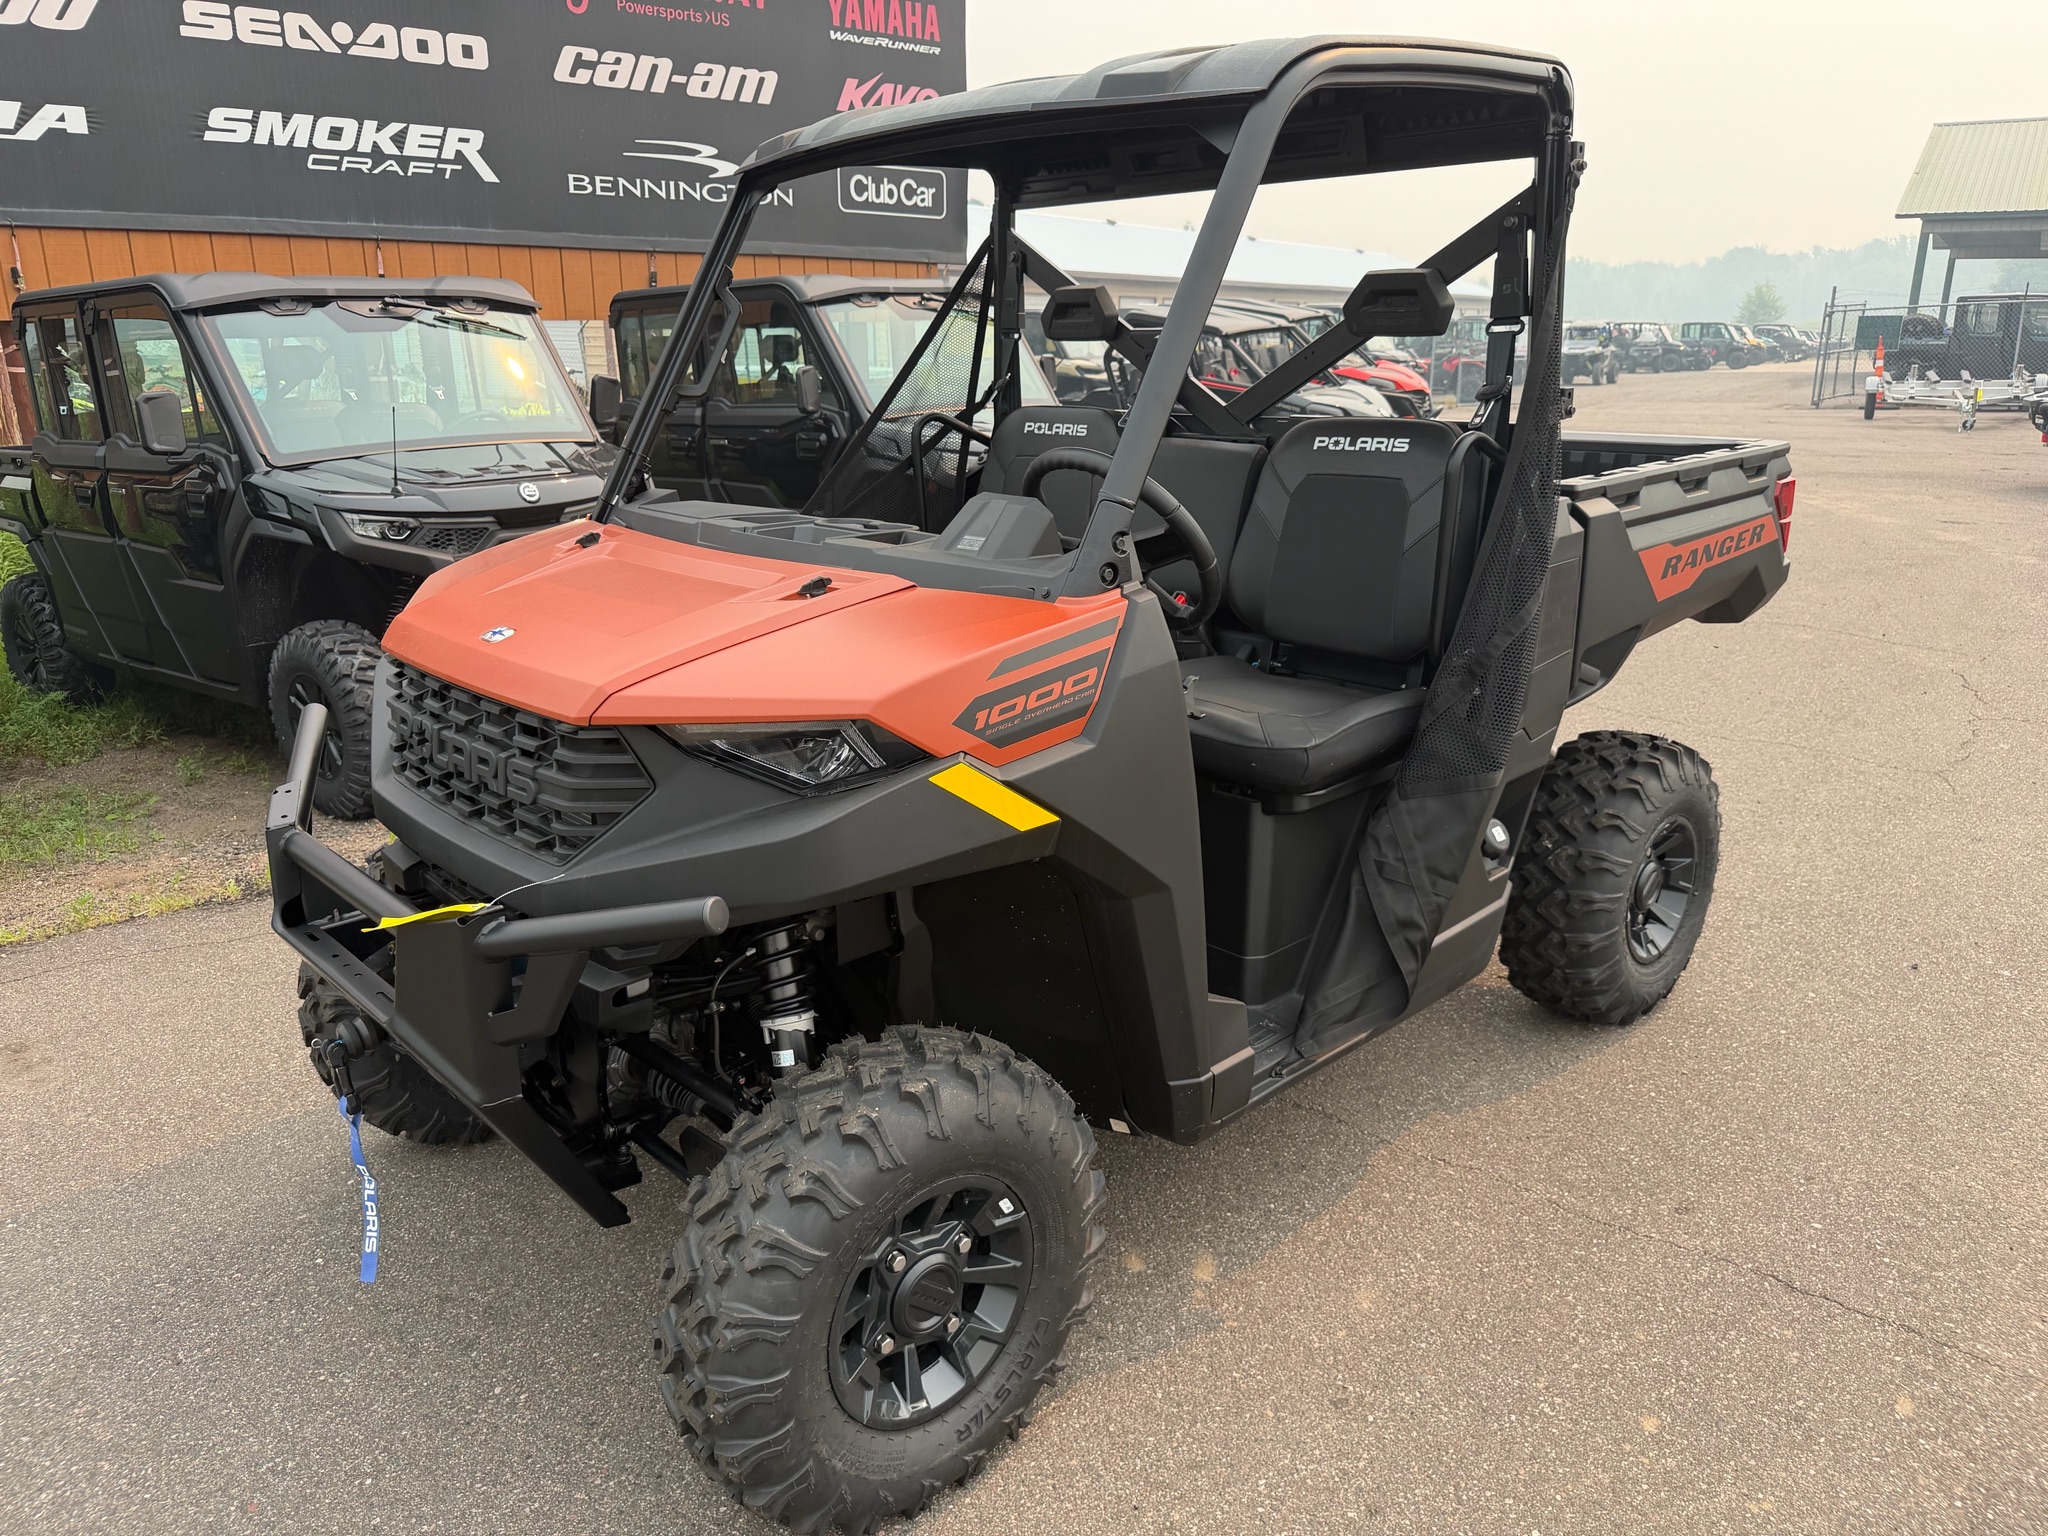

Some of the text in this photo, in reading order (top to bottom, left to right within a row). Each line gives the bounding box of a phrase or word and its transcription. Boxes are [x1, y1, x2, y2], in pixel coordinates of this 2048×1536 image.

[829, 0, 941, 42] YAMAHA
[203, 107, 500, 183] SMOKER
[306, 154, 462, 179] CRAFT
[567, 173, 794, 207] BENNINGN
[849, 174, 936, 208] Club Car
[1023, 421, 1088, 437] POLARIS
[1312, 436, 1410, 453] POLARIS
[1660, 523, 1766, 580] RANGER
[974, 666, 1099, 731] 1000
[985, 688, 1096, 736] SINGLE OVERHEAD CAM
[386, 698, 542, 805] POLARIS
[356, 1164, 378, 1254] POLARIS
